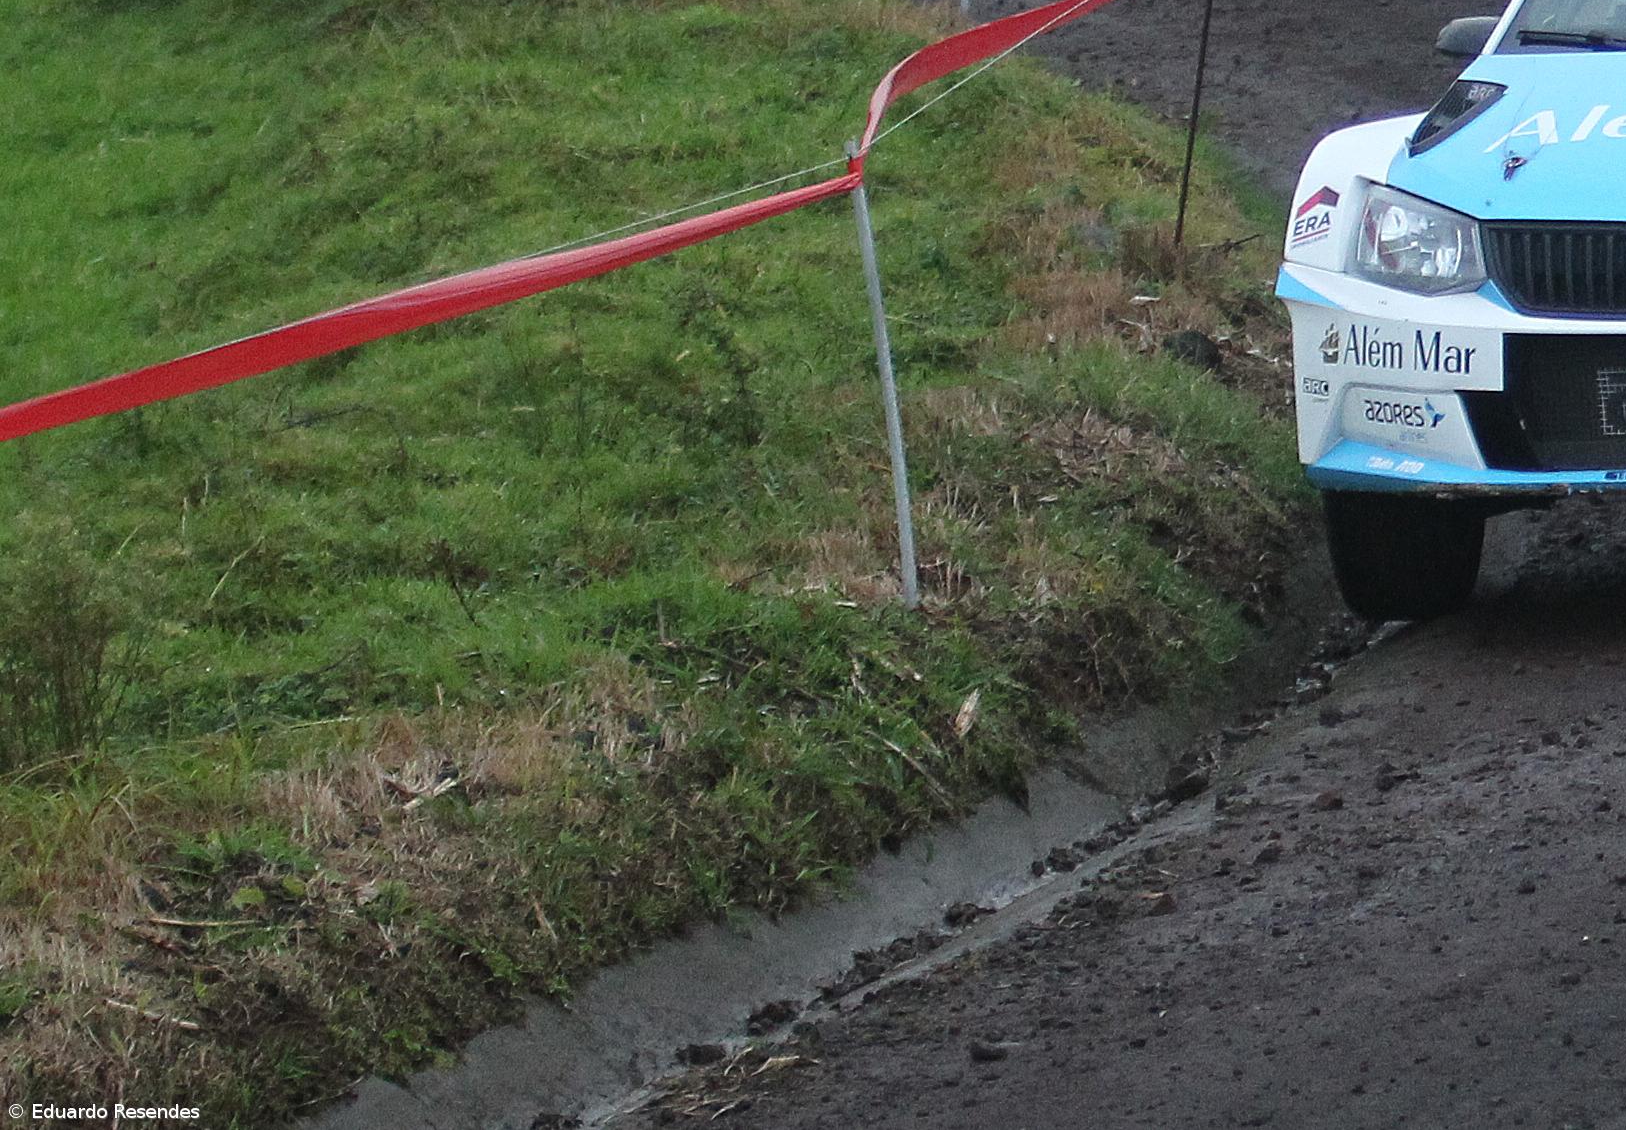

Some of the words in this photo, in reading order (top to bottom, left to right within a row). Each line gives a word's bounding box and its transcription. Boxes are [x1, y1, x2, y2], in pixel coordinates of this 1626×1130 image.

[1293, 211, 1330, 237] ERA
[1343, 324, 1403, 369] Além
[1414, 330, 1476, 374] Mar
